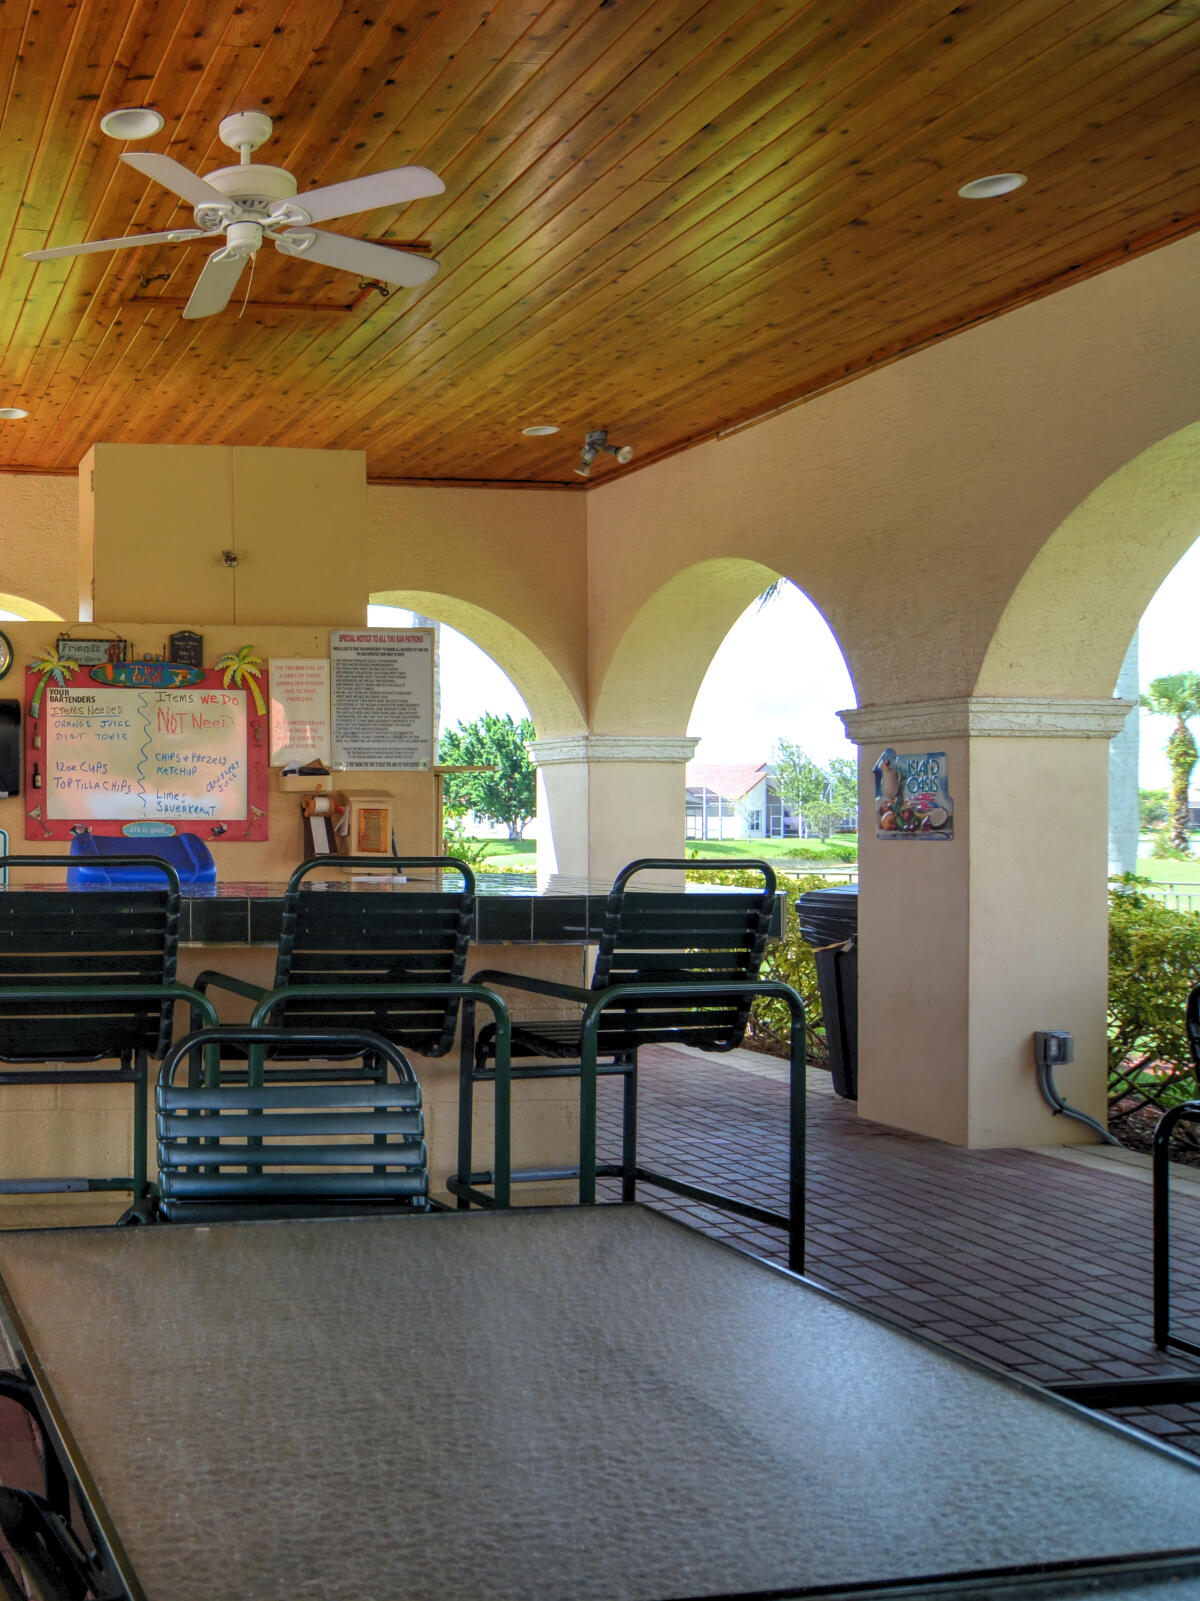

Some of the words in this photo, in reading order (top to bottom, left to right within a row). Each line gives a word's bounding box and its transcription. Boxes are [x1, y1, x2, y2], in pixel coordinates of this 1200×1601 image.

[62, 643, 101, 653] Friends
[49, 695, 96, 703] BARTENDERS
[100, 720, 131, 728] JUICE
[157, 706, 188, 735] NOT
[908, 759, 939, 776] ISLAND
[907, 776, 939, 794] OASIS
